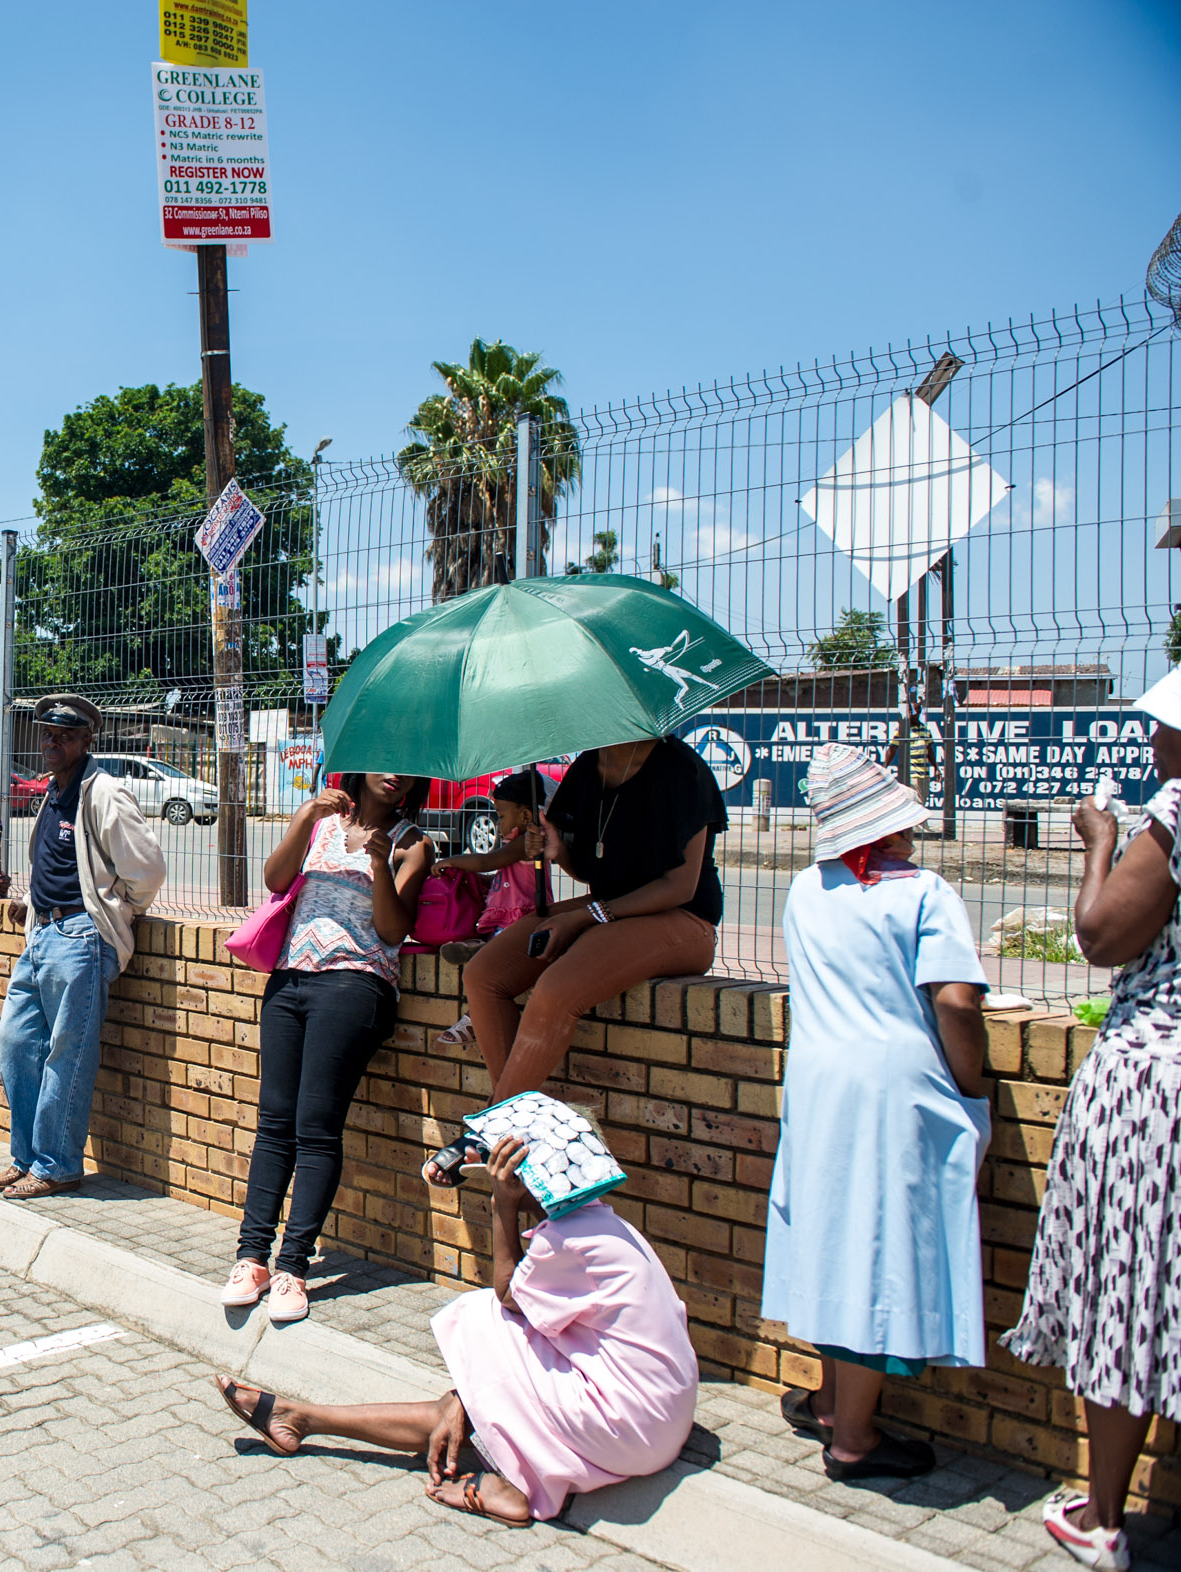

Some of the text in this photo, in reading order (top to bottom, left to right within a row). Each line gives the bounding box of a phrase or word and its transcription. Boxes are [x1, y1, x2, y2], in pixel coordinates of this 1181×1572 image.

[164, 11, 184, 20] 011
[189, 16, 209, 26] 339
[164, 20, 185, 30] 012
[213, 30, 234, 42] 0247
[164, 29, 235, 51] 015 297 0000
[175, 40, 191, 49] A/H:
[157, 70, 260, 88] GREENLANE
[176, 89, 257, 105] COLLEGE
[165, 114, 255, 130] GRADE 8-12
[169, 130, 263, 140] NCS Matric rewrite
[170, 142, 219, 152] N3 Matric
[171, 154, 203, 163] Matric
[217, 156, 224, 164] 6
[226, 156, 265, 164] months
[170, 166, 265, 179] REGISTER NOW
[164, 180, 267, 194] 011 492-1778
[165, 207, 173, 219] 32
[229, 208, 249, 219] Ntemi
[250, 207, 268, 219] Piliso
[183, 224, 251, 238] www.greenlane.co.za
[204, 480, 237, 531] OCEANS
[772, 746, 889, 762] EMECY
[982, 746, 1040, 763] SAME
[1046, 746, 1086, 763] DAY
[1096, 746, 1155, 763] APPR
[288, 758, 313, 770] MPH
[959, 766, 987, 778] ON
[979, 782, 1017, 793] 072
[1022, 782, 1060, 794] 427
[1066, 782, 1122, 795] 458
